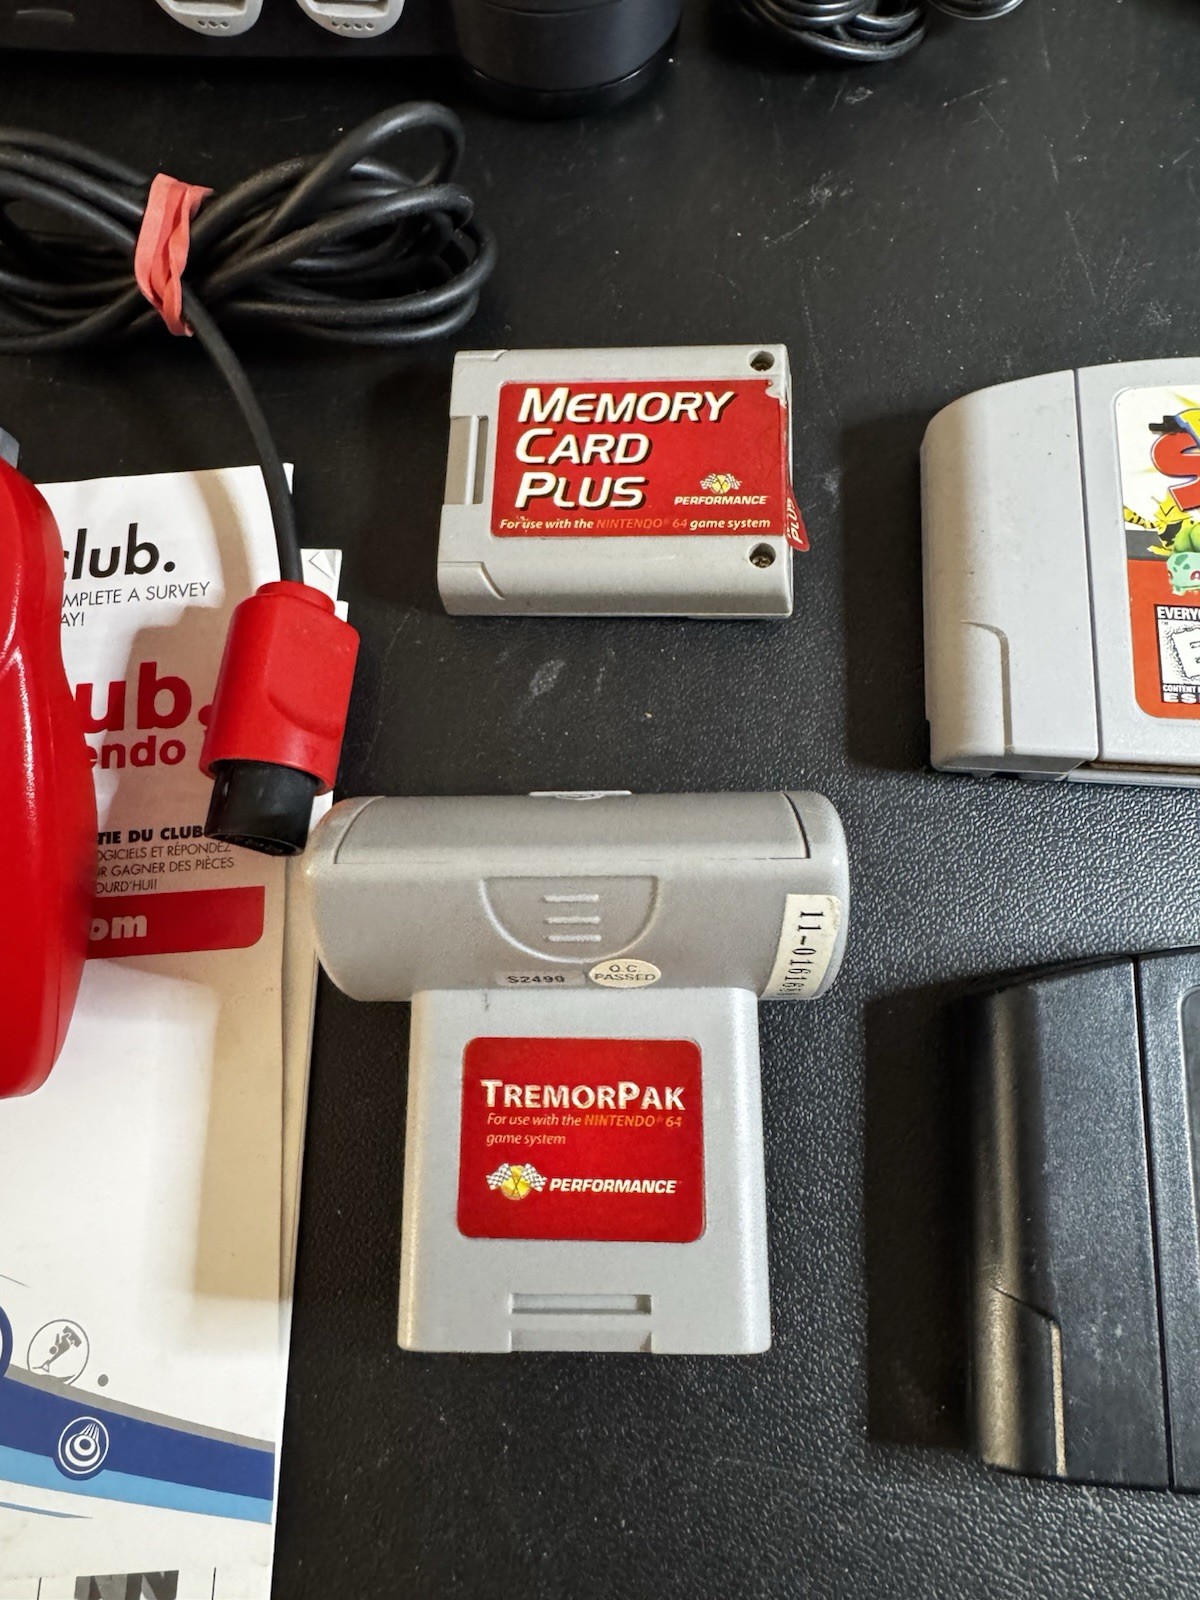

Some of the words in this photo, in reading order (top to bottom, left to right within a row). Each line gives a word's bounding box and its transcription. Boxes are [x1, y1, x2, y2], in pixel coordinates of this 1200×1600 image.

[517, 387, 734, 423] MEMORY
[515, 427, 650, 465] CARD
[514, 471, 646, 509] PLUS
[674, 496, 767, 505] PERFORMANCE
[500, 519, 521, 529] For
[522, 520, 543, 529] use
[545, 518, 572, 529] with
[574, 518, 595, 529] the
[672, 519, 688, 529] 64
[689, 520, 725, 531] game
[727, 518, 771, 531] system
[63, 522, 176, 580] lub.
[62, 588, 123, 608] MPLETE
[127, 587, 140, 602] A
[146, 581, 210, 600] SURVEY
[1157, 606, 1200, 621] EVERY
[1163, 693, 1200, 704] ES
[128, 829, 153, 843] DU
[160, 825, 203, 840] CLUB
[151, 846, 165, 858] ET
[111, 863, 165, 877] GAGNER
[169, 860, 191, 872] DES
[195, 856, 235, 870] PIÈCES
[594, 973, 656, 981] PASSED
[487, 1112, 507, 1125] For
[509, 1116, 529, 1125] use
[531, 1113, 559, 1125] with
[561, 1113, 581, 1126] the
[665, 1115, 683, 1127] 64
[486, 1135, 521, 1147] game
[524, 1134, 566, 1146] system
[550, 1178, 677, 1194] PERFORMANCE
